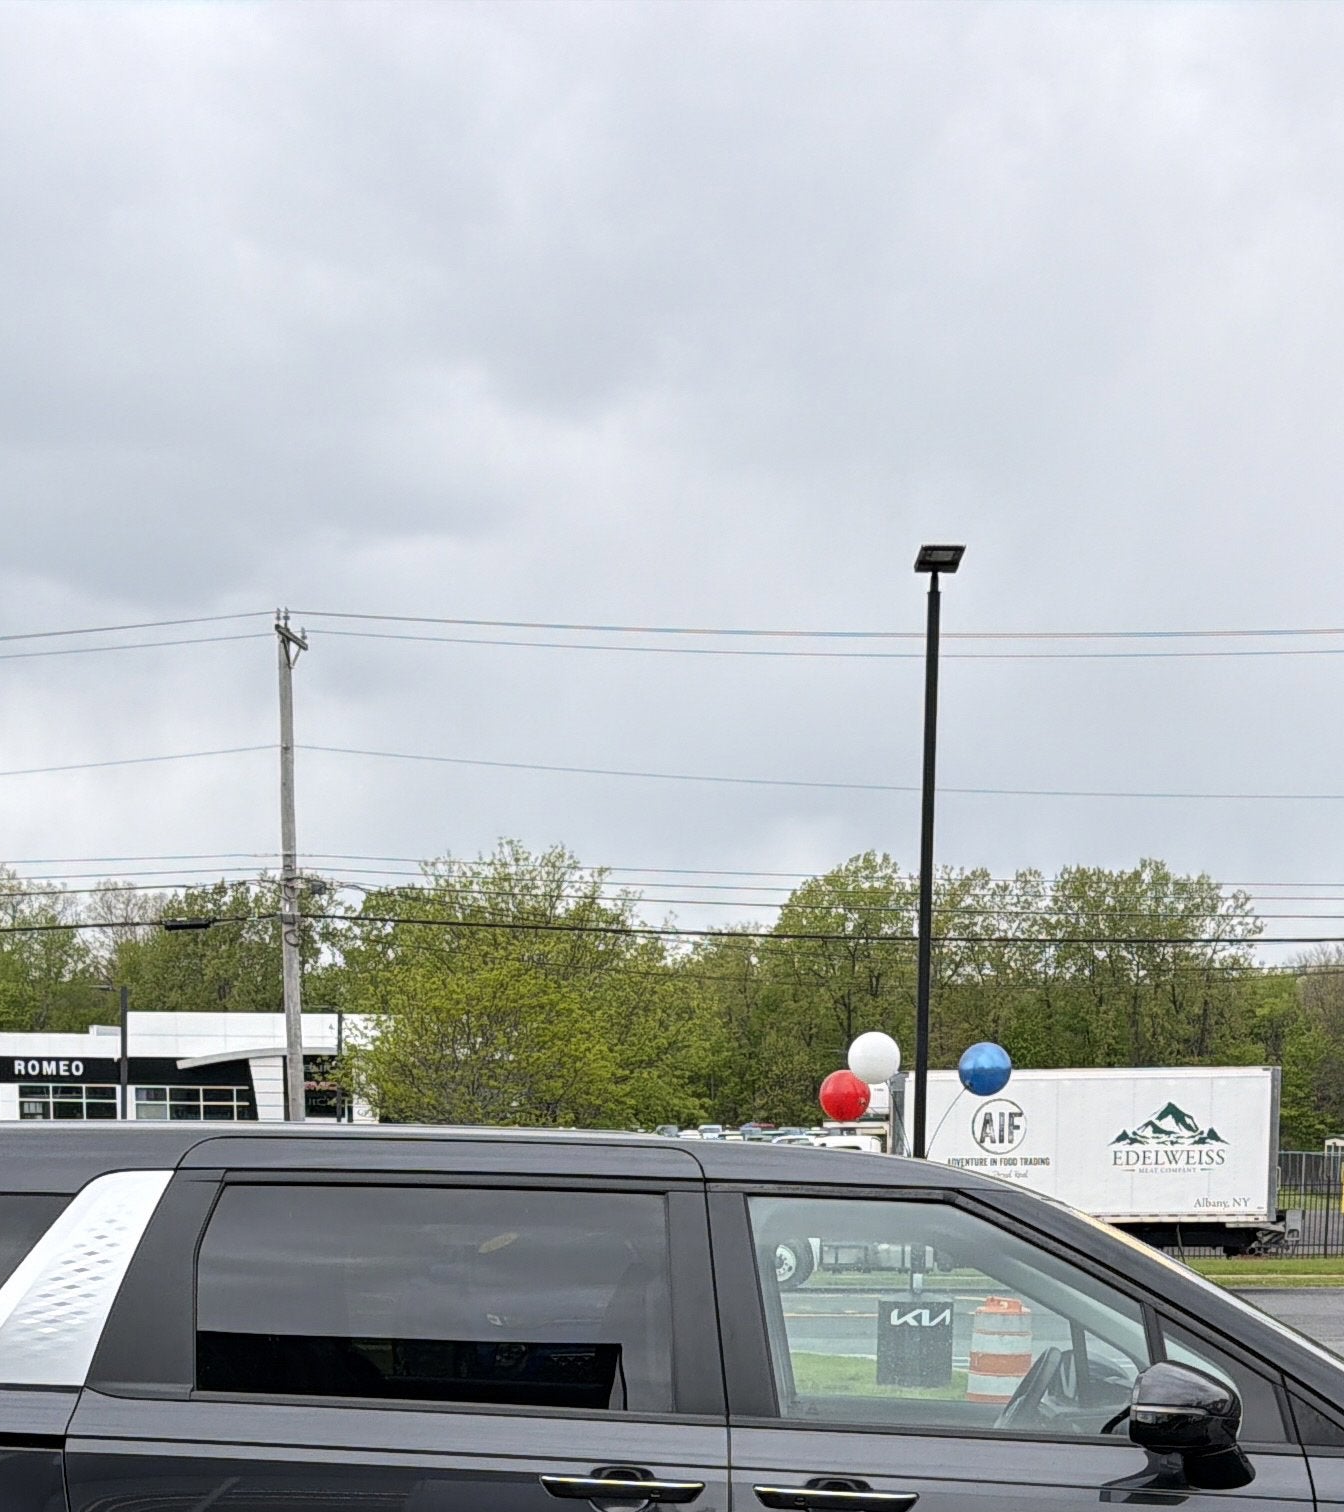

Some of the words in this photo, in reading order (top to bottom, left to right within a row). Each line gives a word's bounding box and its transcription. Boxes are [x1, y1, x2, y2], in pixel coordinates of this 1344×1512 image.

[14, 1060, 84, 1076] ROMEO
[979, 1112, 1024, 1144] AIF
[948, 1158, 988, 1167] ADVENTURE
[990, 1157, 998, 1166] IN
[1000, 1157, 1017, 1166] FOOD
[1020, 1157, 1050, 1166] TRADING
[1112, 1149, 1226, 1166] EDELWEISS
[1194, 1197, 1230, 1210] Albany,
[1233, 1197, 1250, 1208] NY
[890, 1308, 951, 1327] KIA
